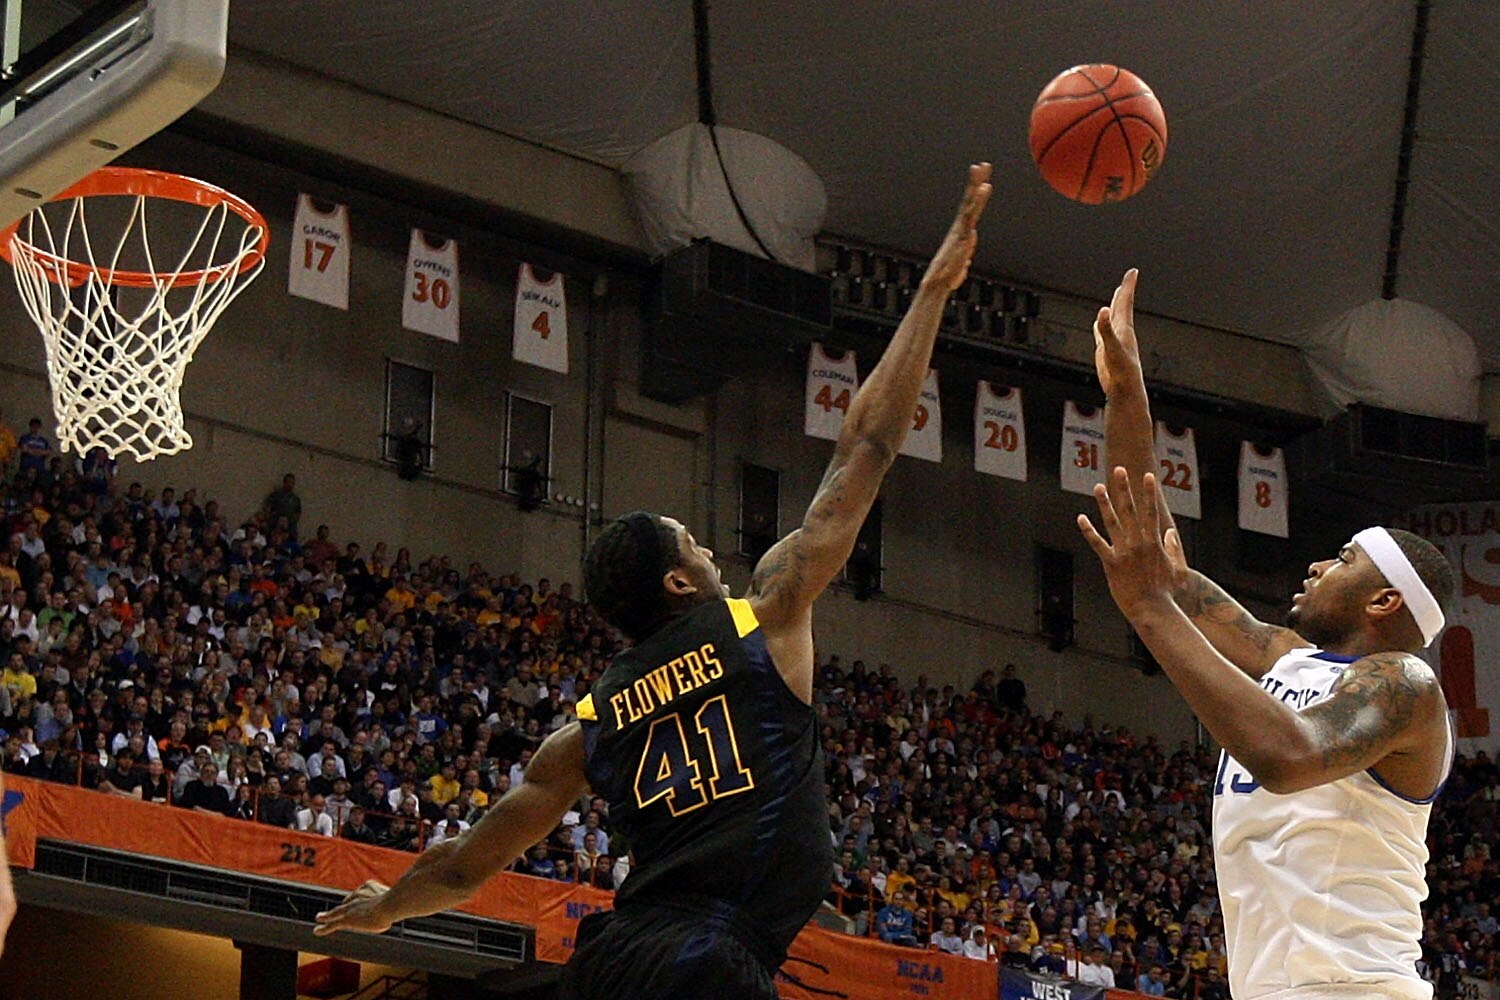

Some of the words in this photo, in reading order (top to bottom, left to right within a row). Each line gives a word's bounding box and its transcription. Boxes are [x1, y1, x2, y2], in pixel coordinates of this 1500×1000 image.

[303, 238, 336, 273] 17
[412, 272, 450, 309] 30
[531, 311, 551, 340] 4
[812, 369, 855, 385] COLEMAN
[814, 384, 850, 416] 44
[912, 405, 929, 431] 9
[983, 421, 1018, 452] 20
[1073, 440, 1098, 470] 31
[1160, 459, 1192, 491] 22
[1254, 481, 1271, 508] 8
[610, 643, 724, 730] FLOWERS
[634, 694, 755, 818] 41
[280, 842, 317, 868] 212
[897, 959, 944, 983] NCAA
